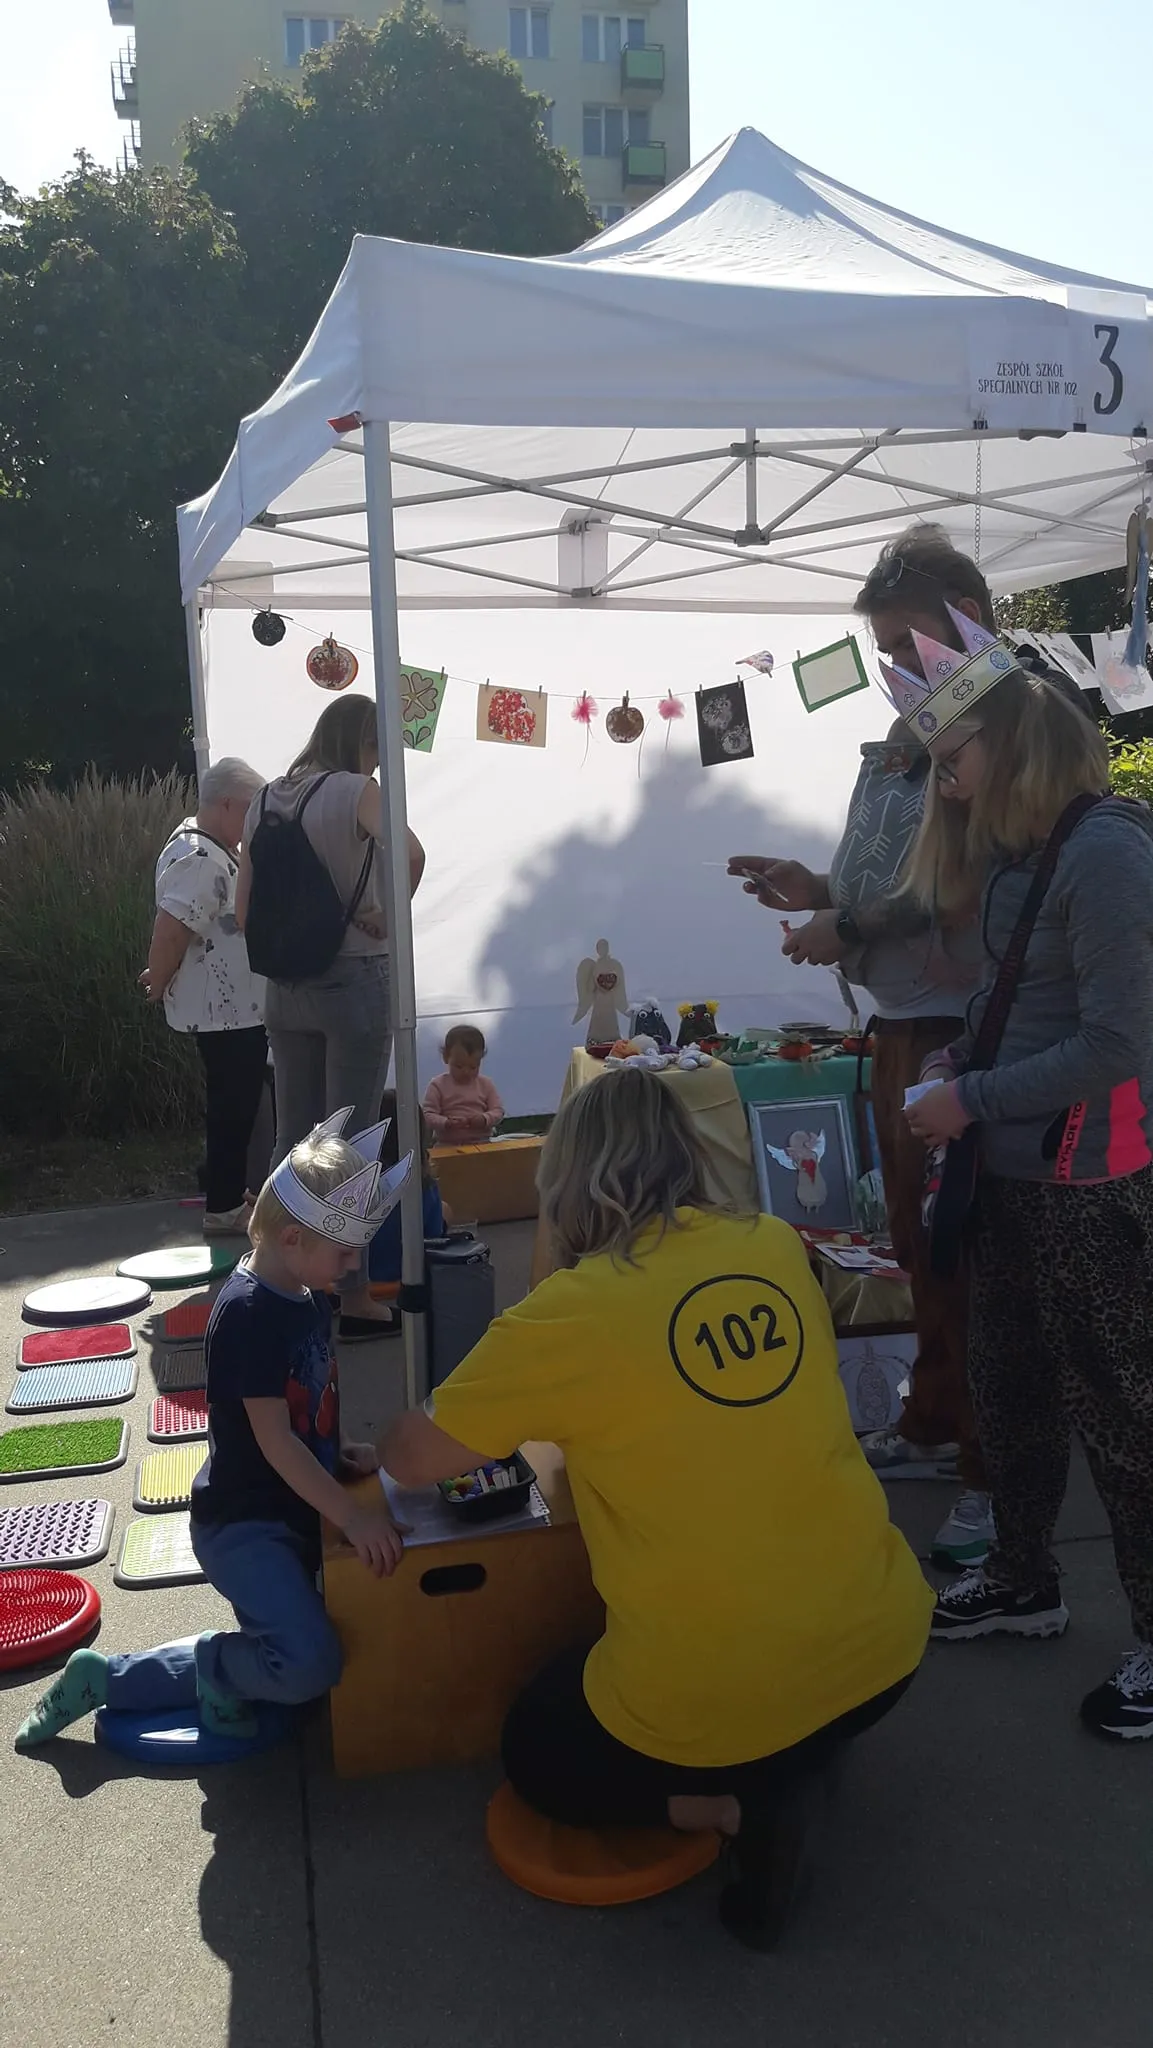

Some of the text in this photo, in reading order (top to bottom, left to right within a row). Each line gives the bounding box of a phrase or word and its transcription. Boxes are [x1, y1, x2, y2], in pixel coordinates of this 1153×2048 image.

[978, 380, 1077, 396] SPECJALNYCH NR 102
[997, 361, 1031, 377] ZESPÓŁ
[1094, 324, 1123, 415] 3
[695, 1304, 787, 1370] 102
